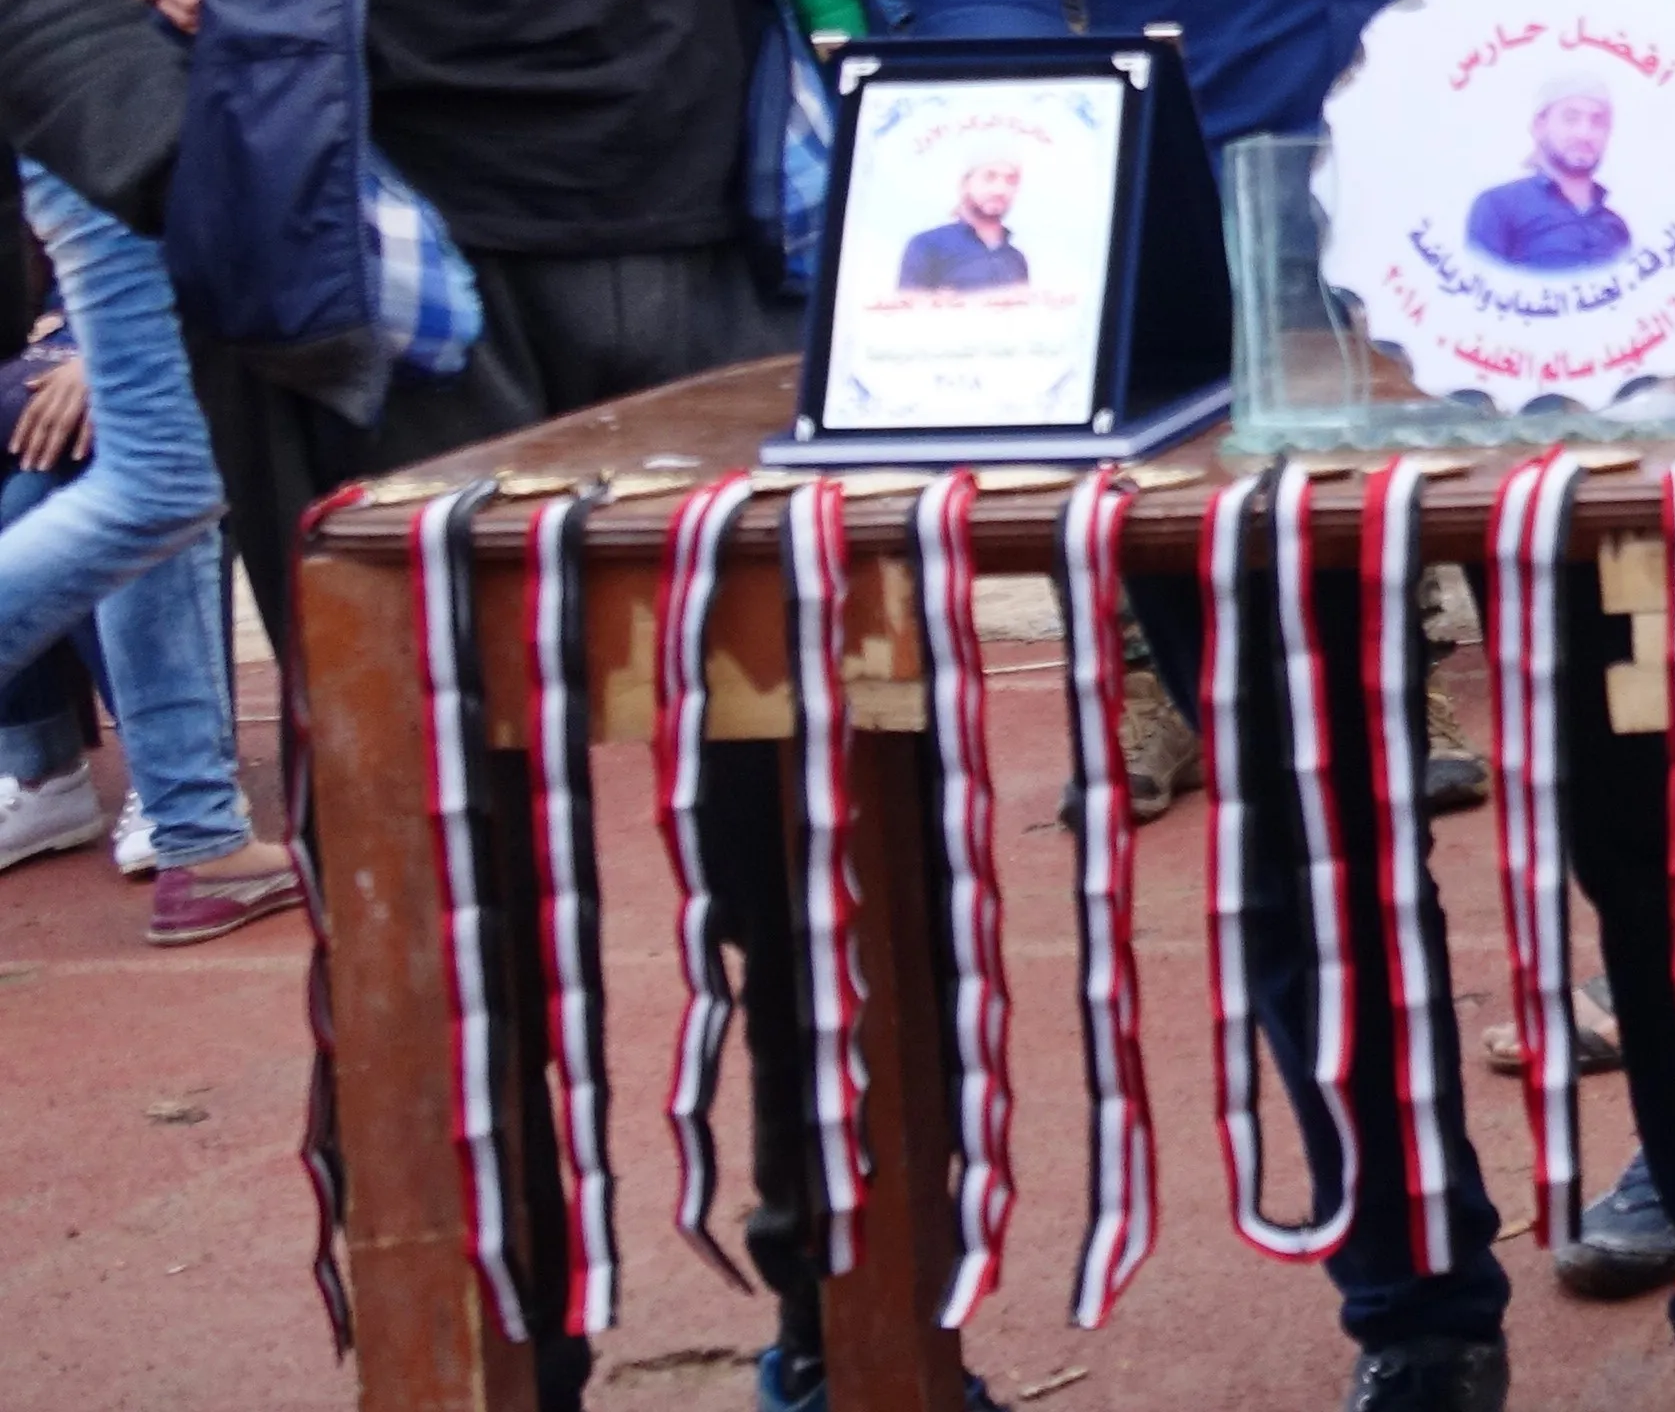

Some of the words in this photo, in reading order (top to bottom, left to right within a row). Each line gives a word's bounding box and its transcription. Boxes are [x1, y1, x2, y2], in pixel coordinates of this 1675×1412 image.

[1450, 23, 1550, 90] حارس
[1407, 217, 1492, 311] والرياضة
[1494, 287, 1568, 327] الشباب
[1571, 276, 1621, 312] لجنة
[1603, 310, 1674, 374] الشهيد
[1538, 352, 1595, 388] سالم
